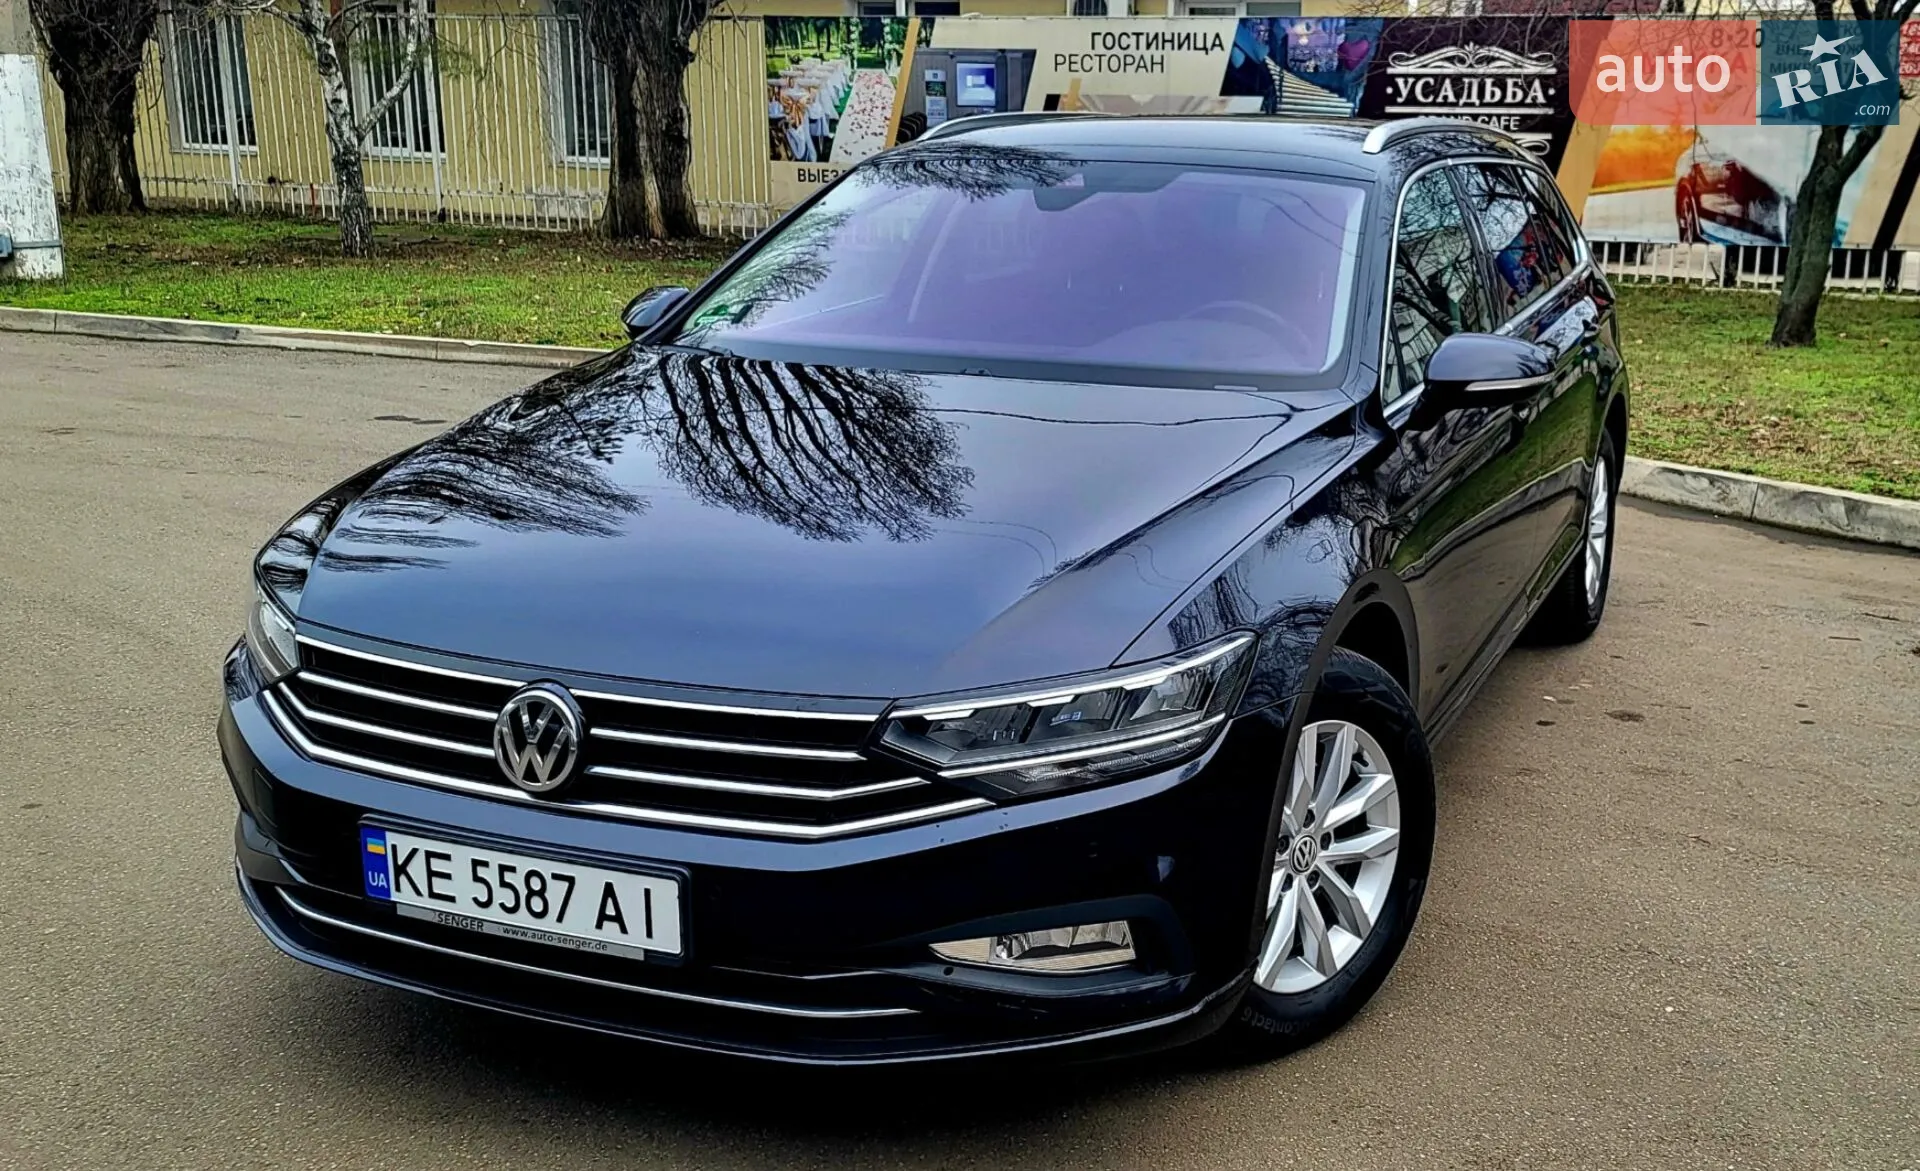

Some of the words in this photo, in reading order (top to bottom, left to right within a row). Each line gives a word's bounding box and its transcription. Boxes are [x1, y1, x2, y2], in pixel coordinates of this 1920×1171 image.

[1090, 31, 1225, 54] ГОСТИНИЦА
[1054, 53, 1165, 74] РЕСТОРАН
[1394, 77, 1547, 106] УСАДЬБА
[1476, 116, 1521, 131] CAFE
[797, 168, 846, 183] ВЫЕЗ
[368, 870, 388, 889] UA
[390, 843, 457, 904] KE
[470, 858, 576, 924] 5587
[595, 880, 653, 940] AI
[437, 912, 484, 932] SENGER
[502, 926, 608, 951] www.auto-senger.de
